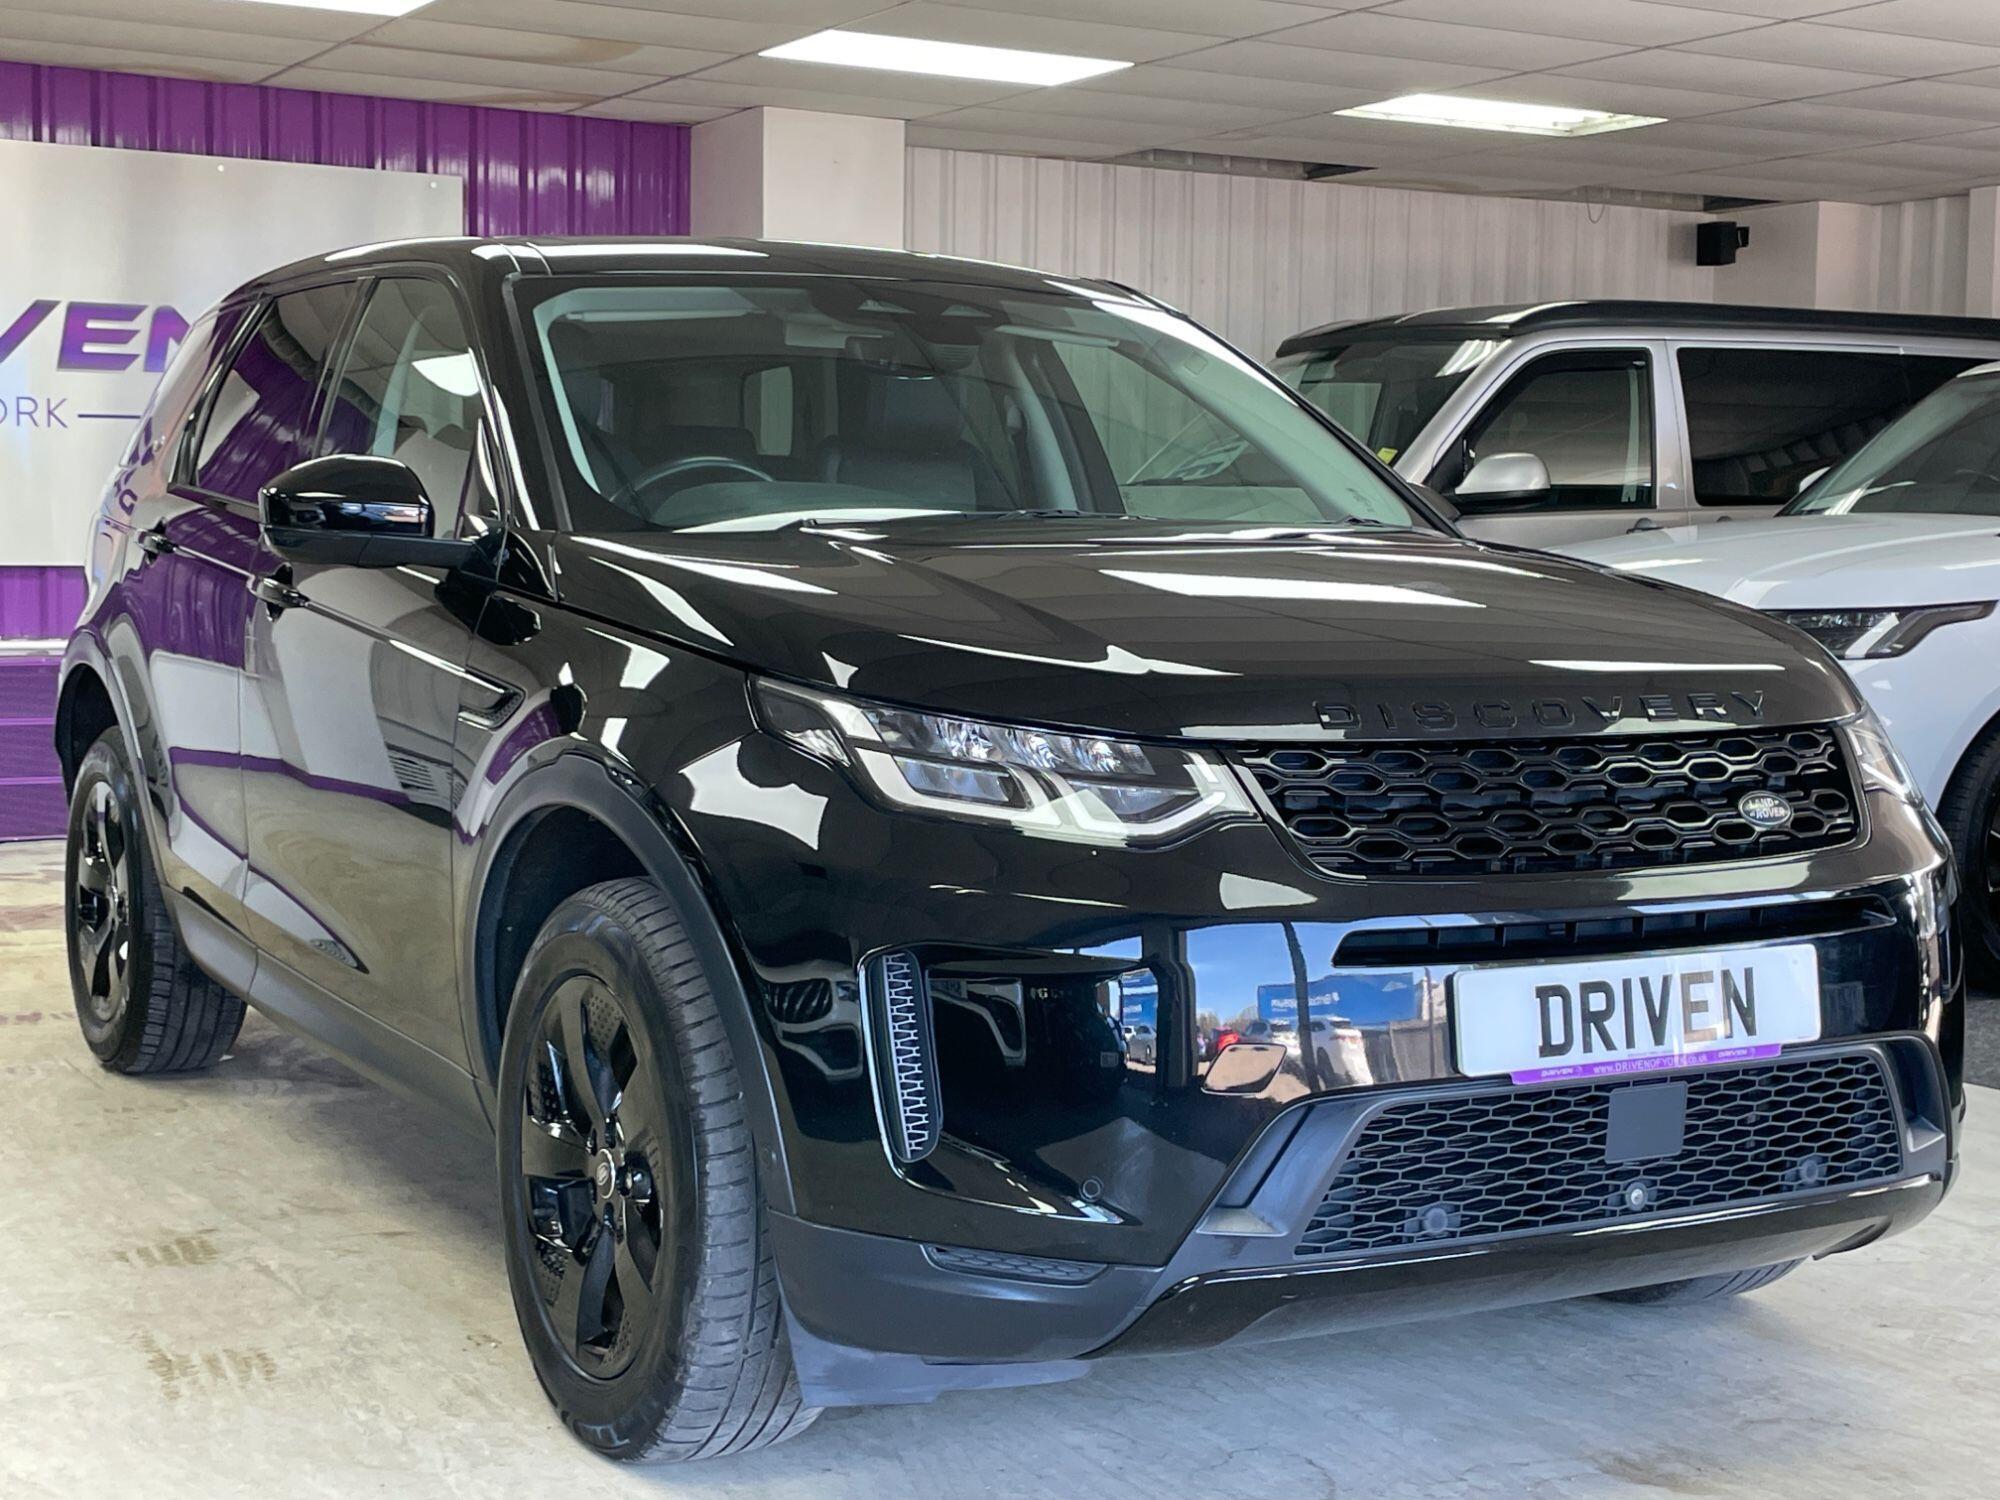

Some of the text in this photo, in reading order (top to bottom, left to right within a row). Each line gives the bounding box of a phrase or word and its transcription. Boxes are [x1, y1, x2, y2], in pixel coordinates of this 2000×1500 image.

[1312, 689, 1765, 731] DISCOVERY
[1747, 797, 1775, 809] LAND
[1755, 806, 1786, 819] ROVER
[1533, 966, 1757, 1058] DRIVEN
[1592, 1053, 1708, 1075] www.DRIVENOFYO.co.uk
